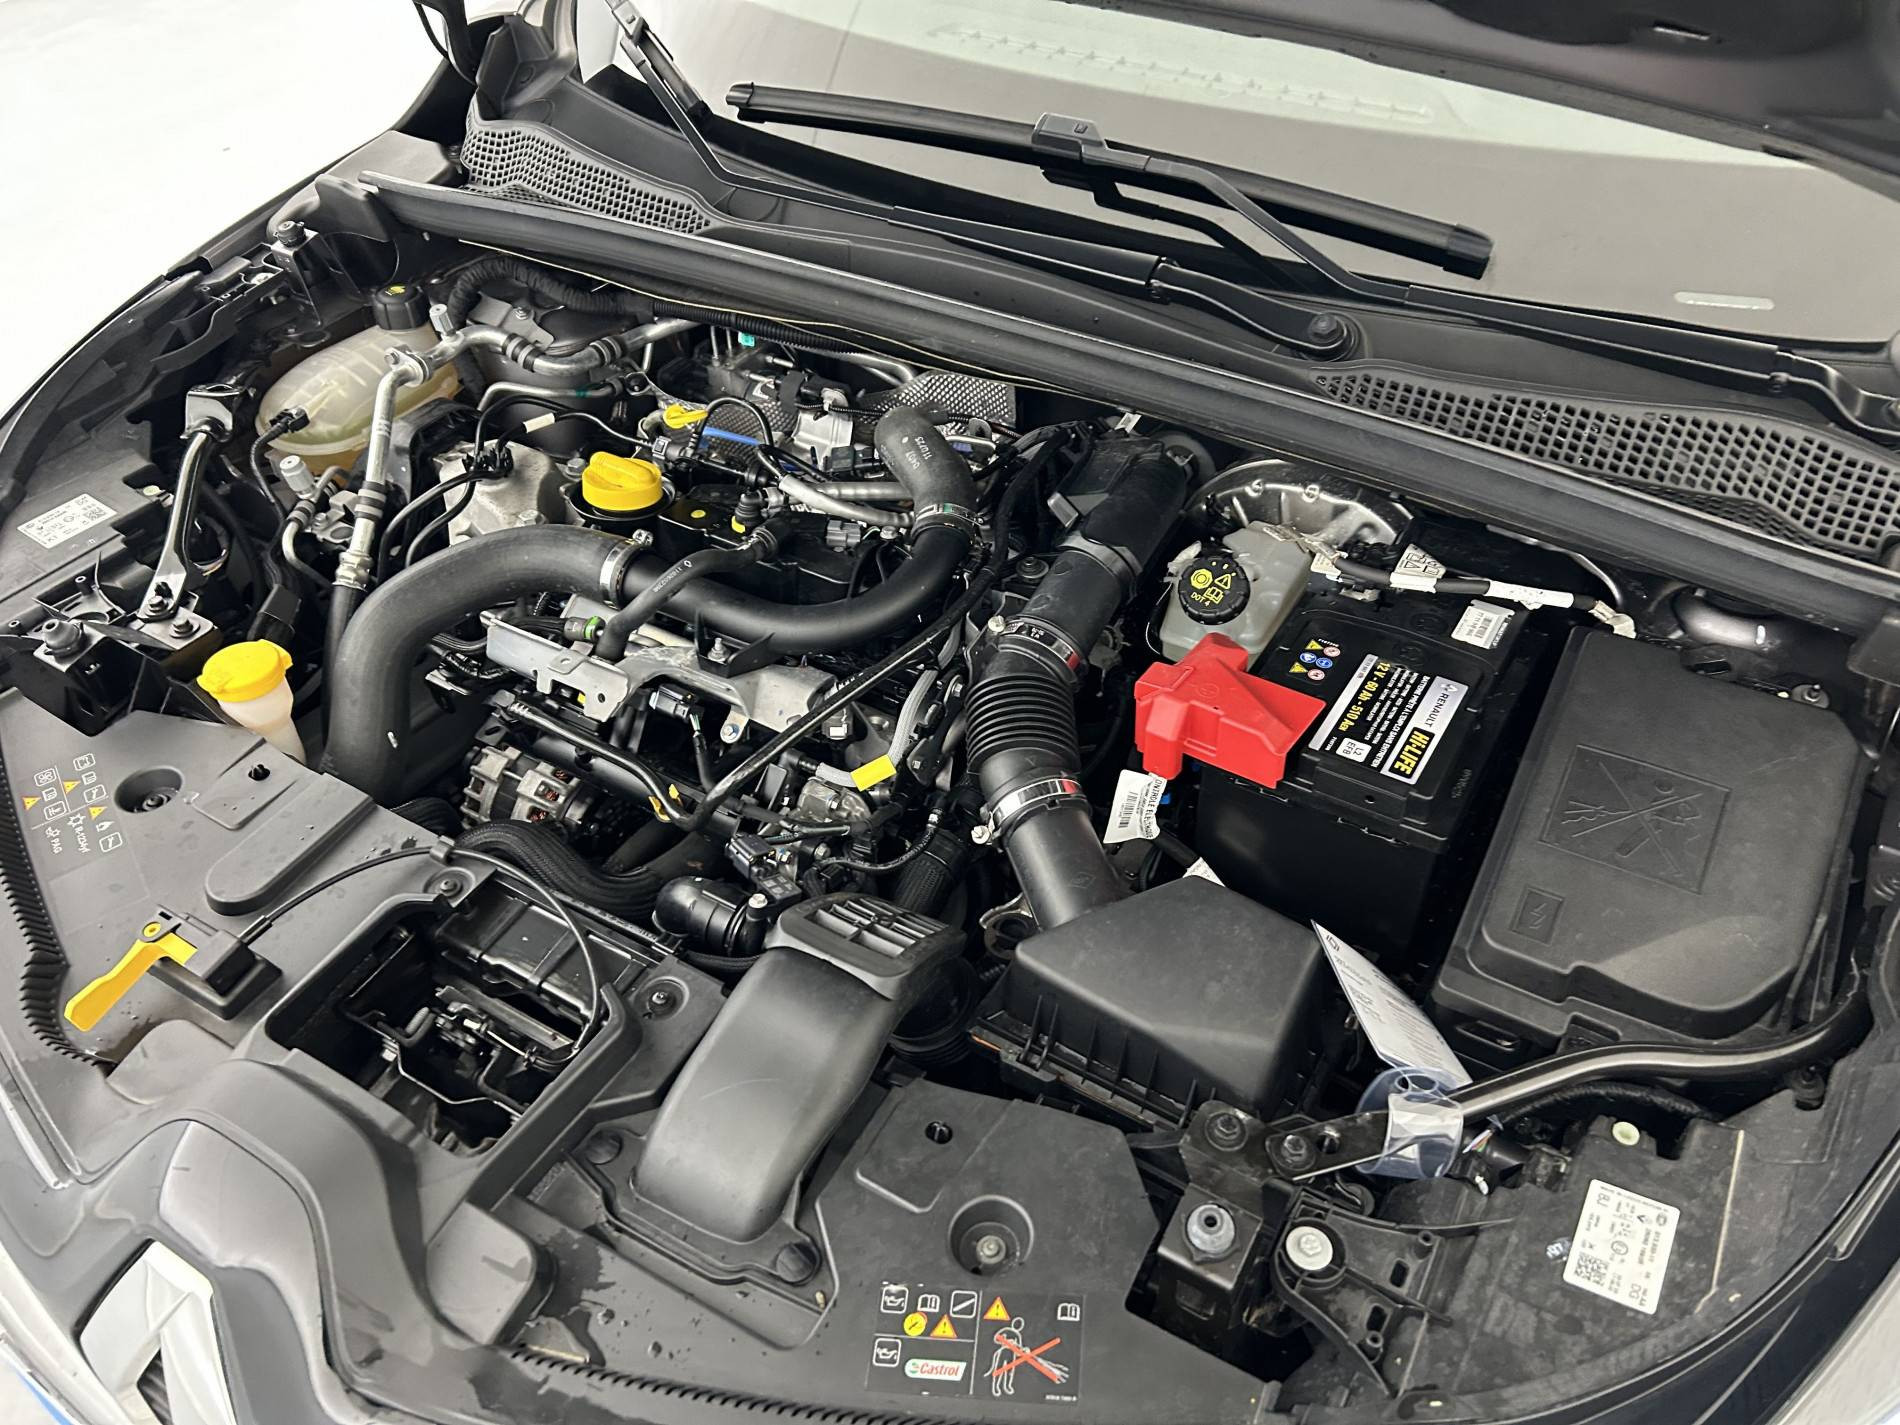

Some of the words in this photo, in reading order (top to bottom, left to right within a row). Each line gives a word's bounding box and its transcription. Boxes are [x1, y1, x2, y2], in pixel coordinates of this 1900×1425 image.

[1190, 591, 1206, 603] DOT
[1376, 661, 1391, 672] 12
[1373, 670, 1386, 678] V
[1364, 680, 1379, 692] 60
[1412, 674, 1431, 696] BATTERIE
[1358, 690, 1374, 702] Ah
[1346, 705, 1364, 720] 510
[1424, 692, 1449, 727] RENAULT
[1341, 740, 1356, 755] EFB
[1352, 746, 1364, 756] L2
[919, 1362, 959, 1376] Castrol
